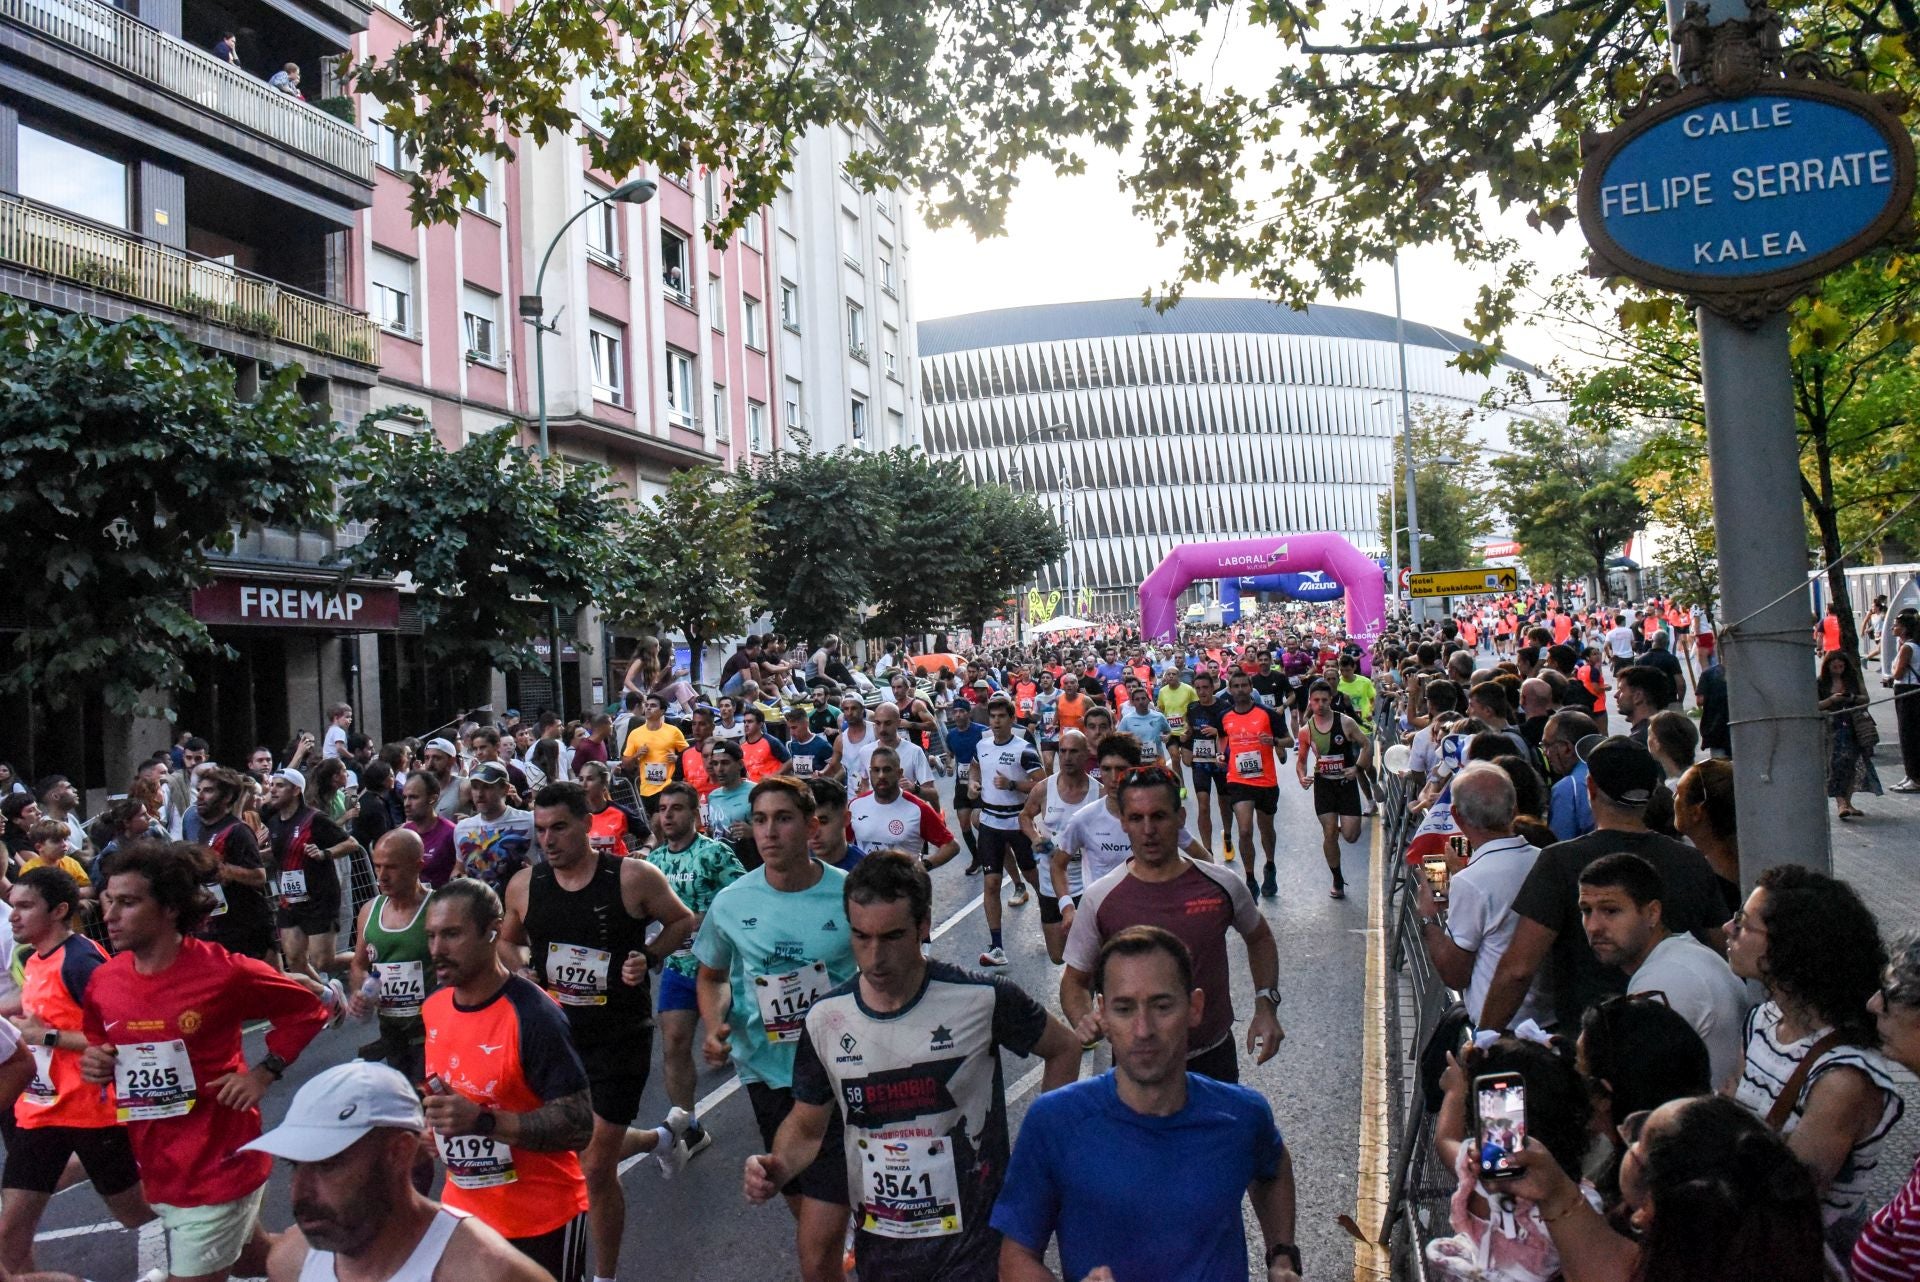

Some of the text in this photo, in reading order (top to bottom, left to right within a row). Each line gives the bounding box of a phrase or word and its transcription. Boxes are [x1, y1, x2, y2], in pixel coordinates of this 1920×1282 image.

[1682, 102, 1792, 138] CALLE
[1601, 149, 1892, 218] FELIPE SERRATE
[1693, 230, 1807, 264] KALEA
[1218, 555, 1265, 567] LABORAL
[1411, 577, 1434, 585] Hotel
[1436, 585, 1483, 593] Euskalduna
[240, 586, 363, 621] FREMAP
[556, 965, 597, 984] 1976
[384, 980, 420, 996] 1474
[836, 1054, 863, 1063] FORTUNA
[127, 1067, 179, 1089] 2365
[846, 1087, 862, 1103] 58
[443, 1136, 496, 1158] 2199
[872, 1171, 932, 1198] 3541
[895, 1202, 931, 1210] MIZUNO
